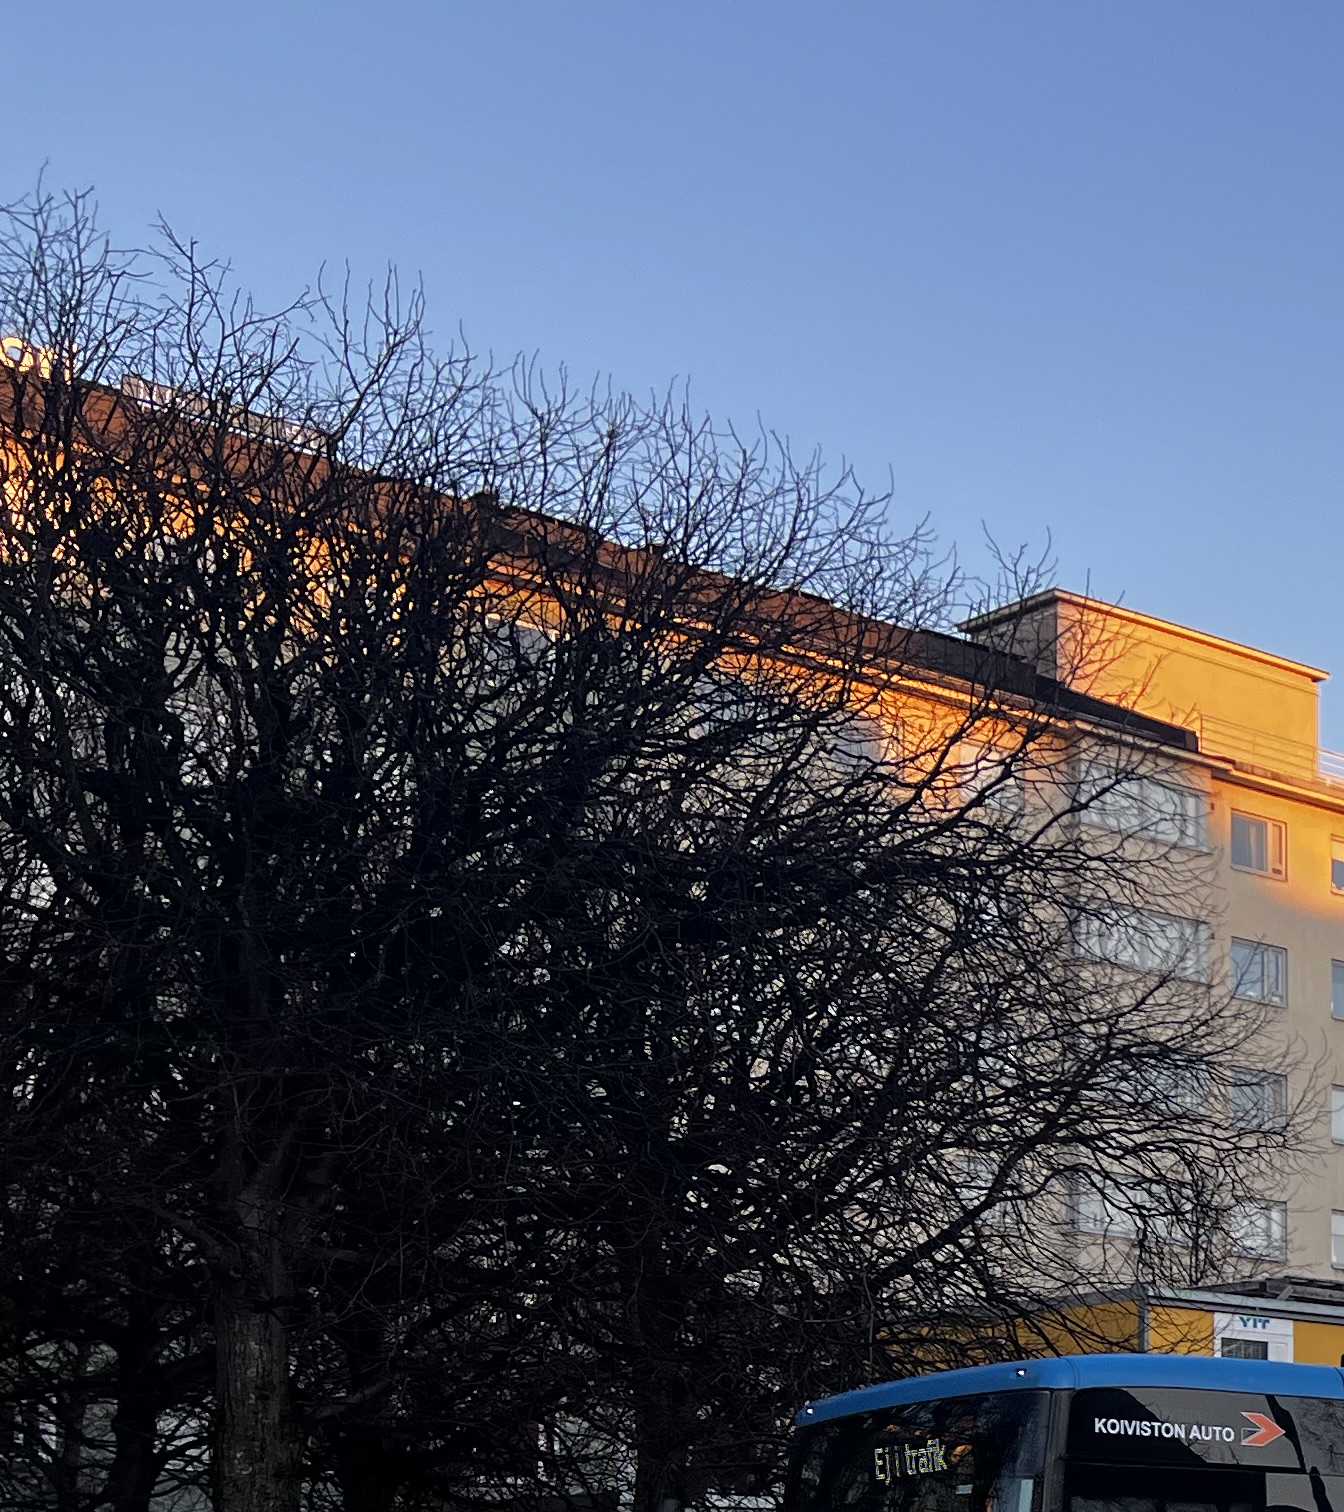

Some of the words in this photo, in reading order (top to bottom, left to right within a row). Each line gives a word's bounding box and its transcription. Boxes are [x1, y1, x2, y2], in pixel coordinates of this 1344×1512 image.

[1239, 1316, 1270, 1329] YIT
[1094, 1418, 1184, 1439] KOIVISTON
[1189, 1424, 1235, 1442] AUTO
